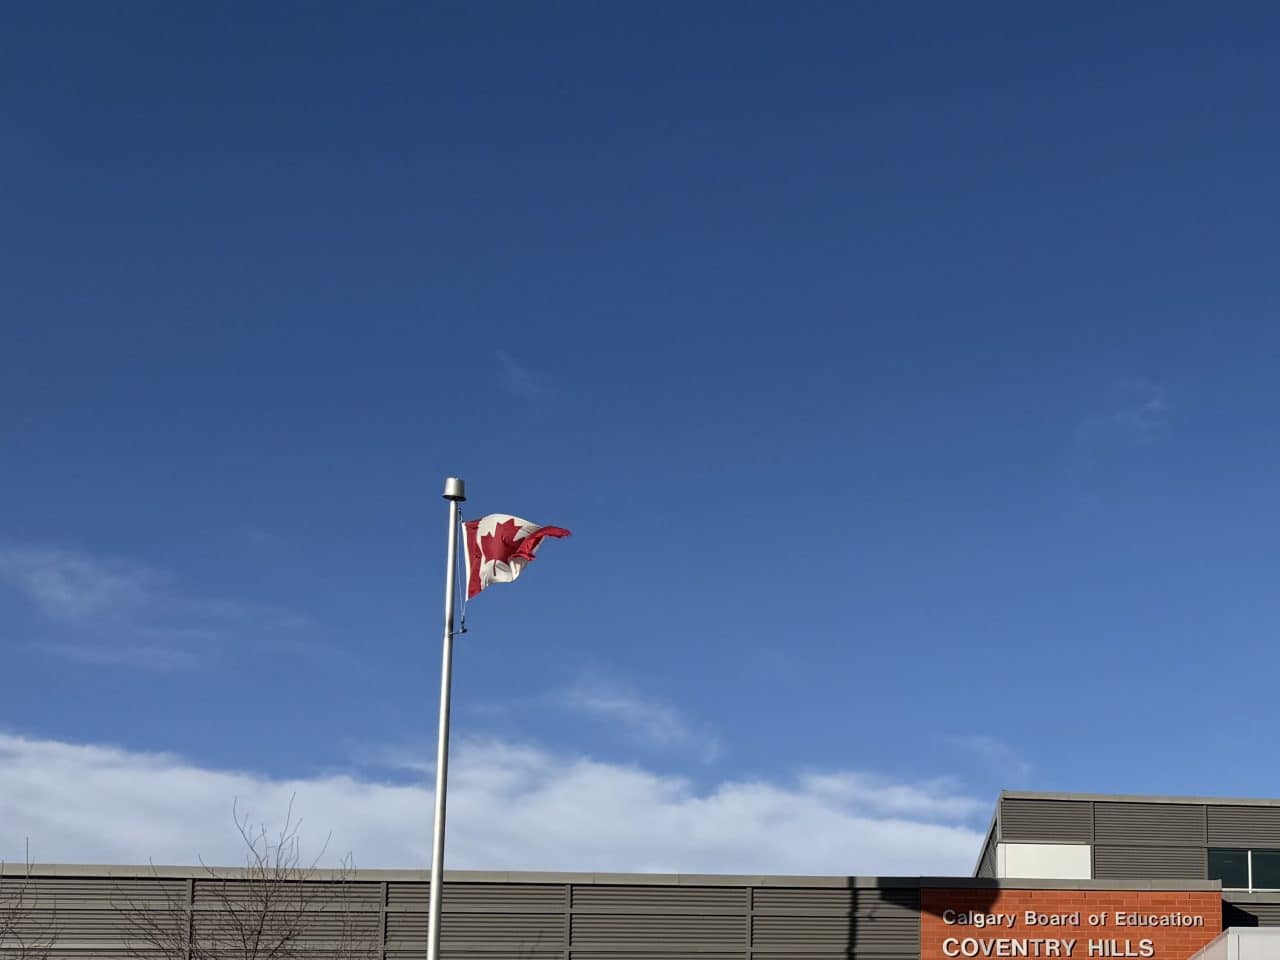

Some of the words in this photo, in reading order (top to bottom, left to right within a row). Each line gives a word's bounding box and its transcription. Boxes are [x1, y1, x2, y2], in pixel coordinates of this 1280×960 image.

[942, 909, 1016, 928] Calgary
[1024, 910, 1080, 926] Board
[1088, 912, 1107, 926] of
[1115, 911, 1204, 927] Education
[942, 937, 1077, 957] COVENTRY
[1088, 938, 1155, 957] HILLS
